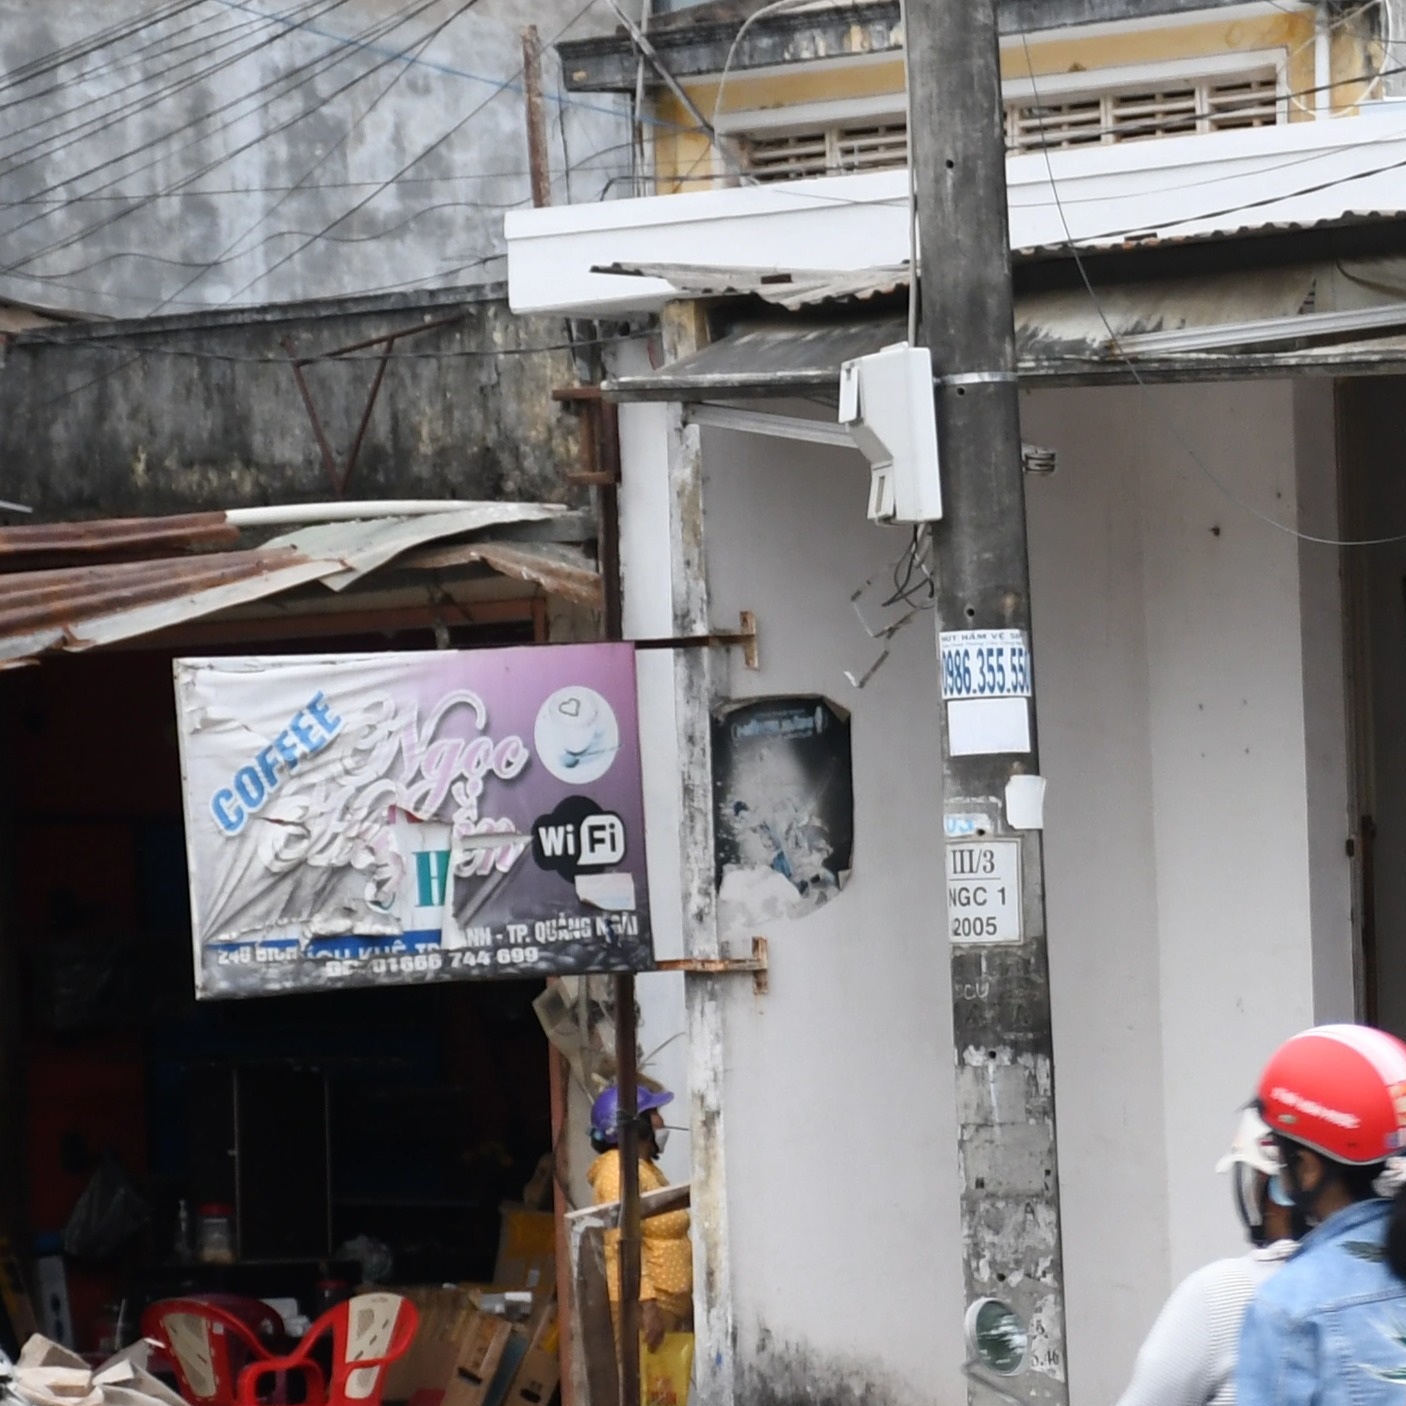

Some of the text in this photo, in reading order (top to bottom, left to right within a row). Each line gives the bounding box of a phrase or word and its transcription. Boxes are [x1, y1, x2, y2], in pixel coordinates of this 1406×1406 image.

[211, 689, 344, 837] COFFEE
[952, 915, 998, 938] 2005
[449, 949, 494, 970] 744
[497, 945, 539, 965] 699
